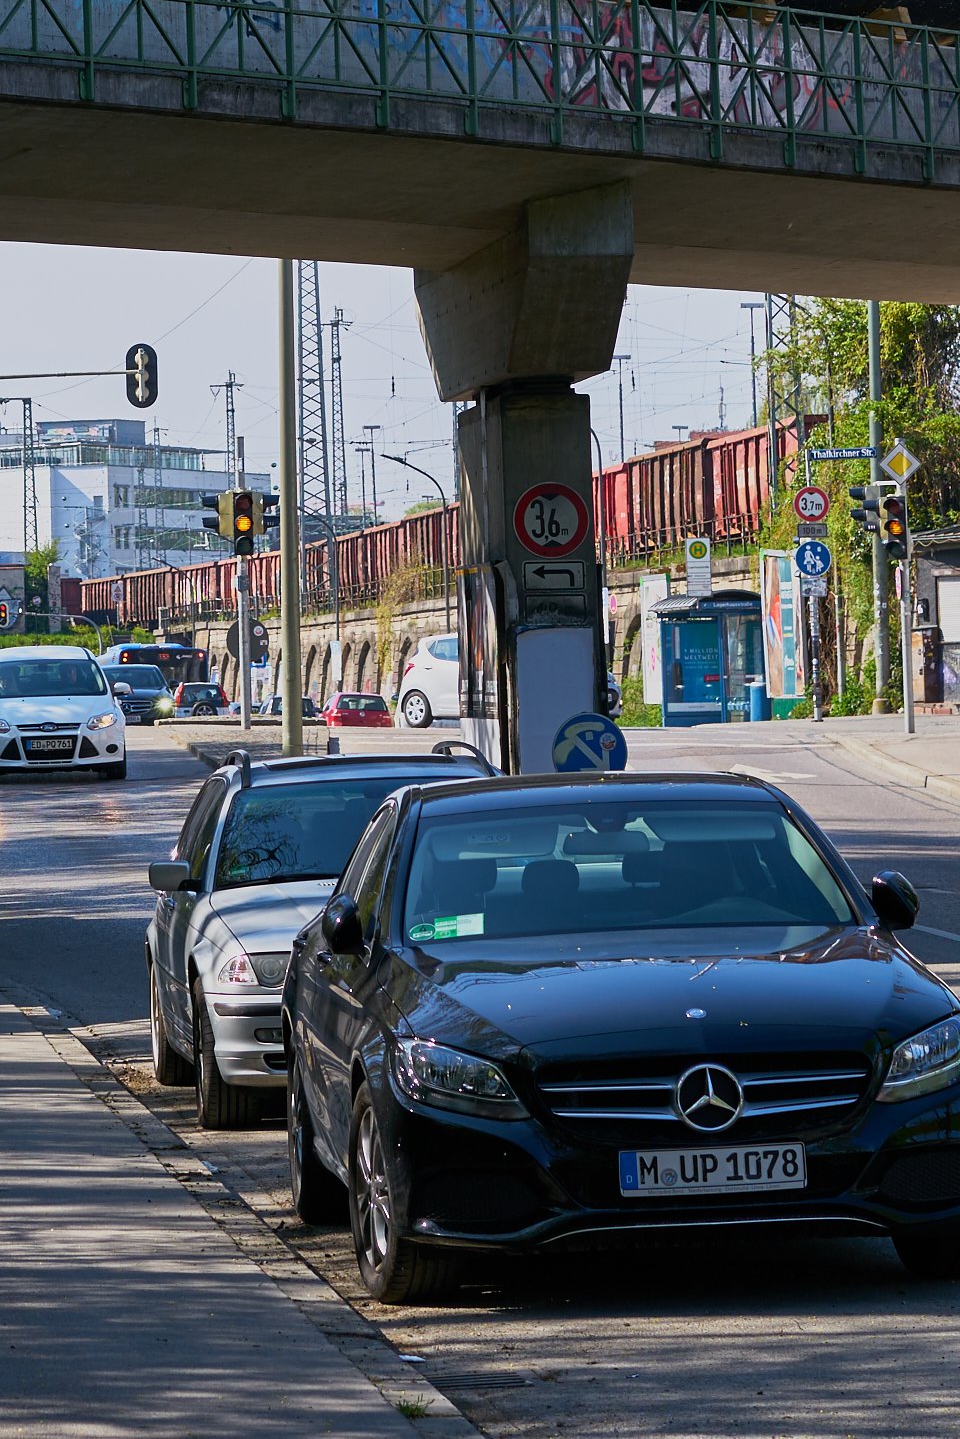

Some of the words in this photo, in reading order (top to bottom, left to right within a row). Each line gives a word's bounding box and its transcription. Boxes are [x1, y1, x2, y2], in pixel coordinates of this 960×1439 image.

[812, 449, 860, 459] Thalkirchner
[861, 448, 874, 457] Str.
[31, 740, 42, 749] ED
[57, 739, 72, 748] 761
[639, 1156, 659, 1185] M
[679, 1153, 719, 1183] UP
[726, 1149, 799, 1181] 1078
[626, 1175, 633, 1184] D
